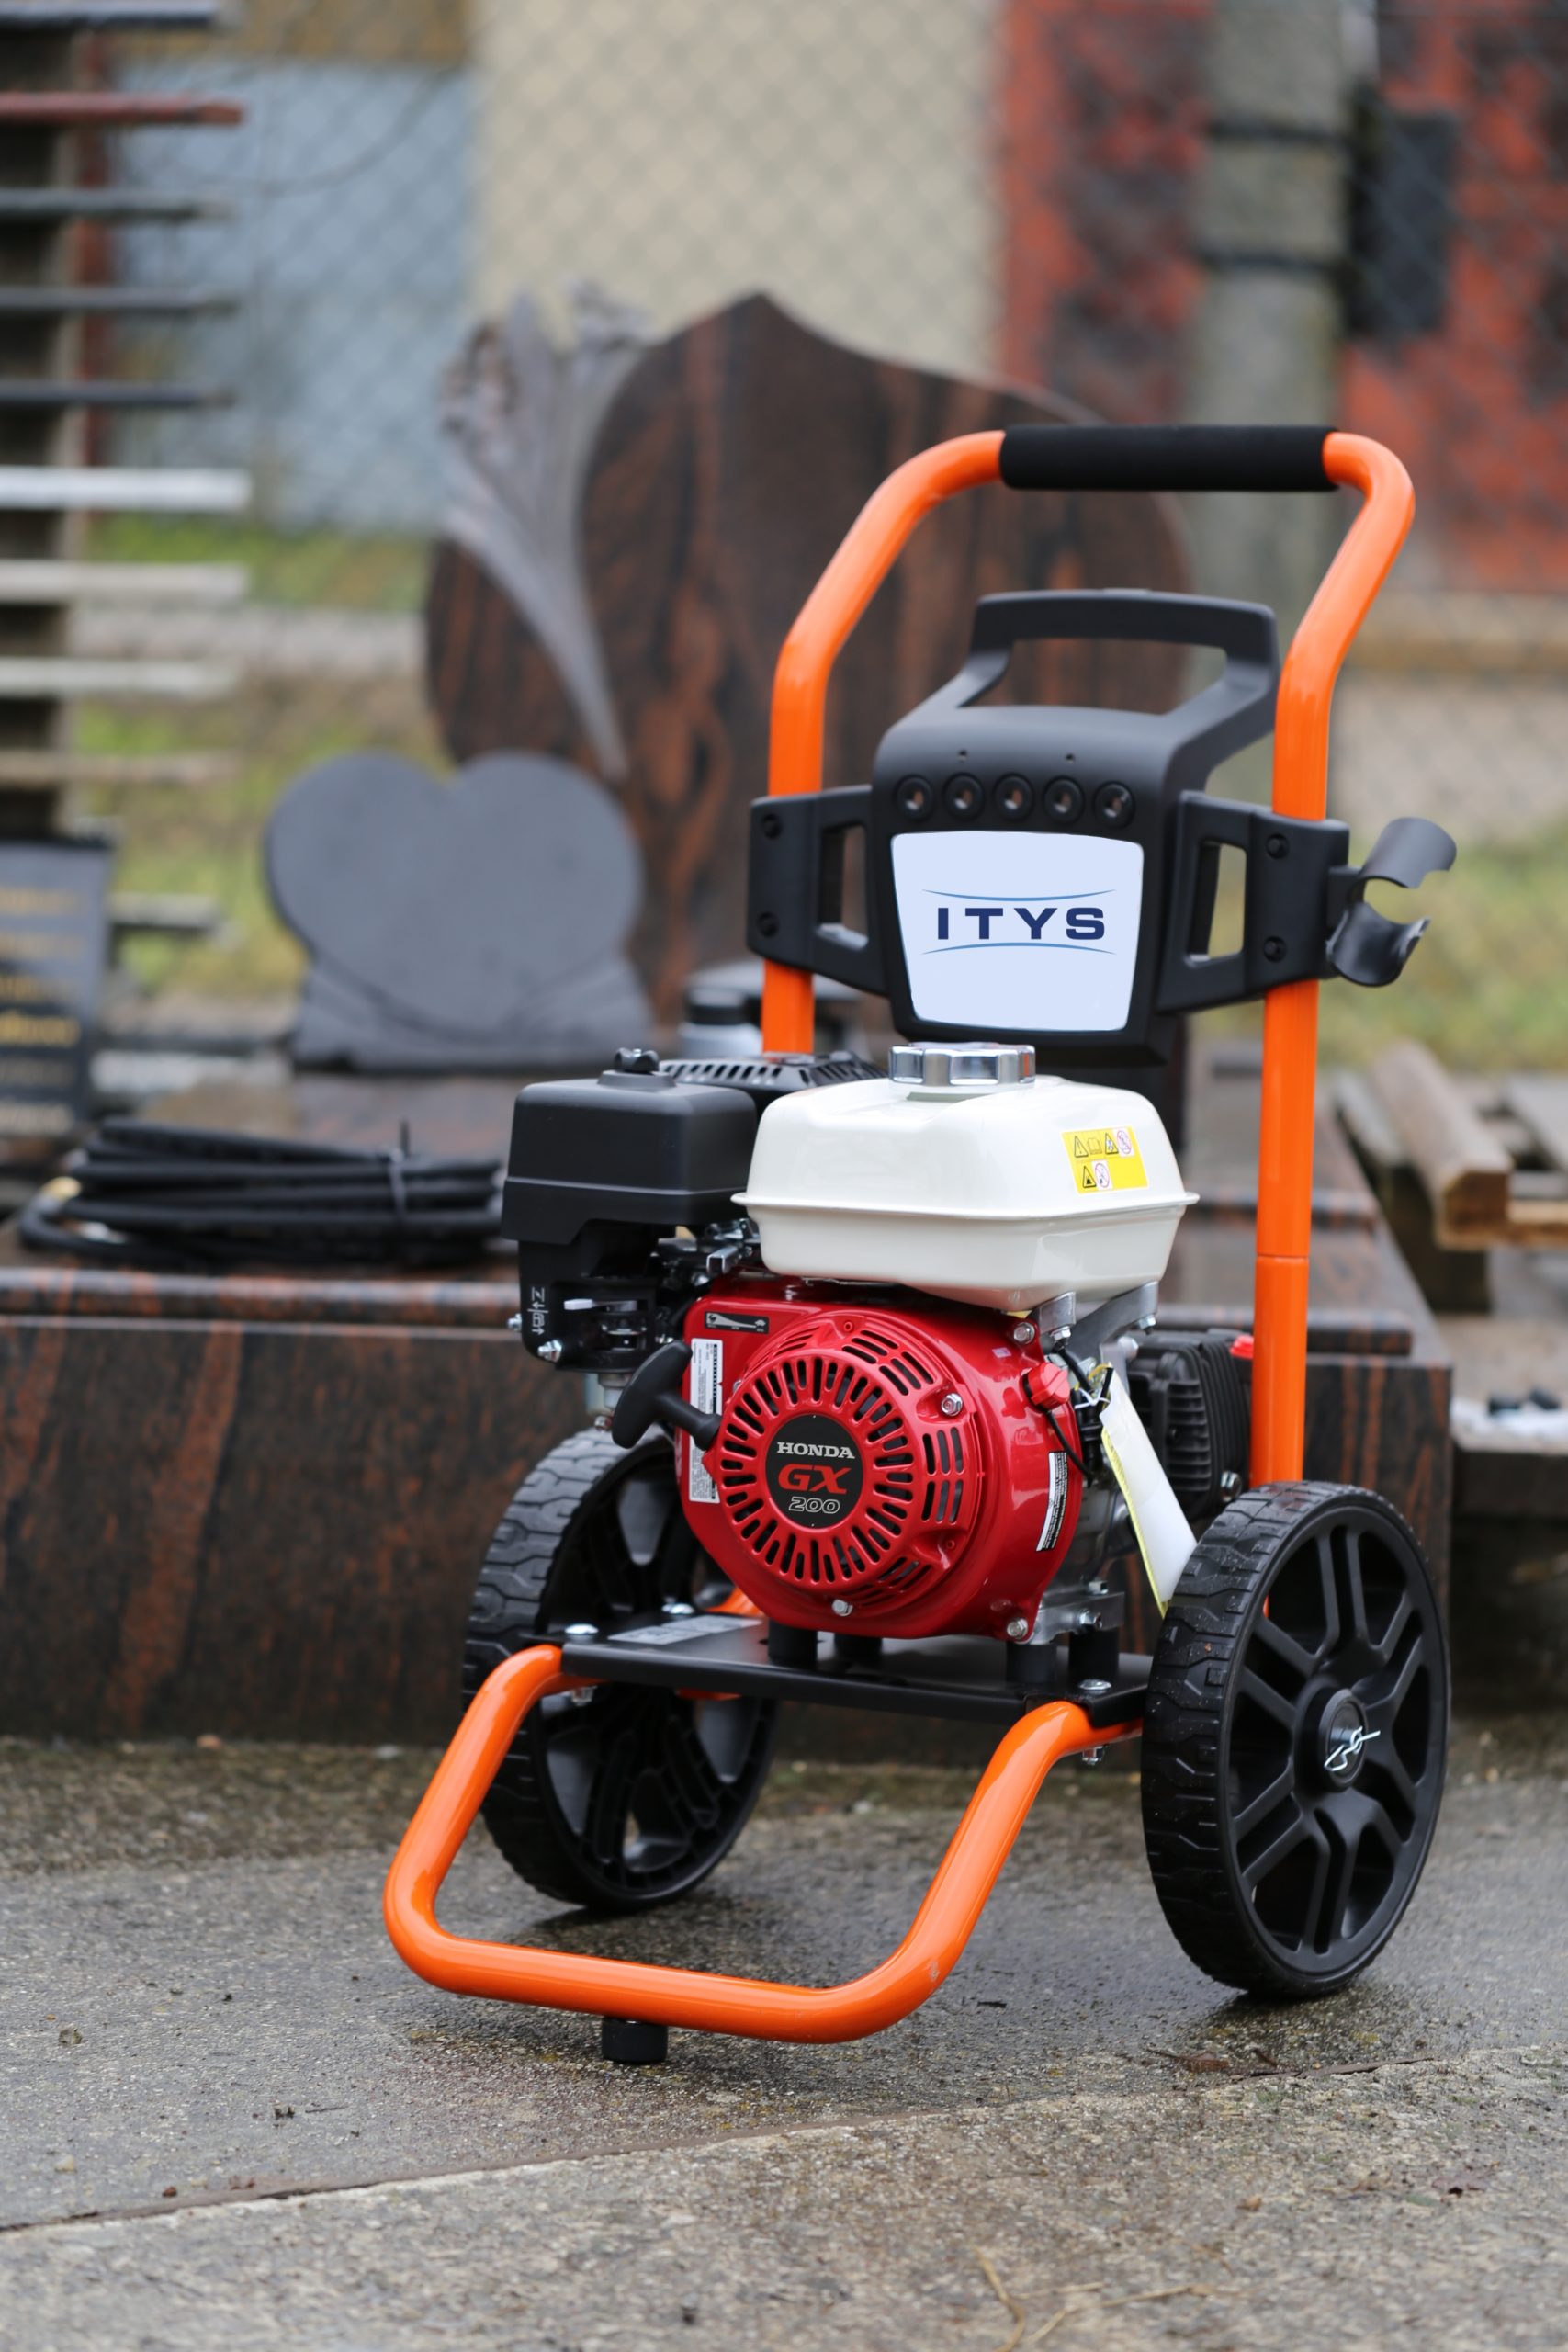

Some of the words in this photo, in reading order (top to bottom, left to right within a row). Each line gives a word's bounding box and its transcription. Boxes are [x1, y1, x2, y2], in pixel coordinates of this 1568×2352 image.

[937, 907, 1105, 941] ITYS
[777, 1442, 856, 1459] HONDA
[778, 1464, 852, 1495] GX
[788, 1496, 840, 1514] 200
